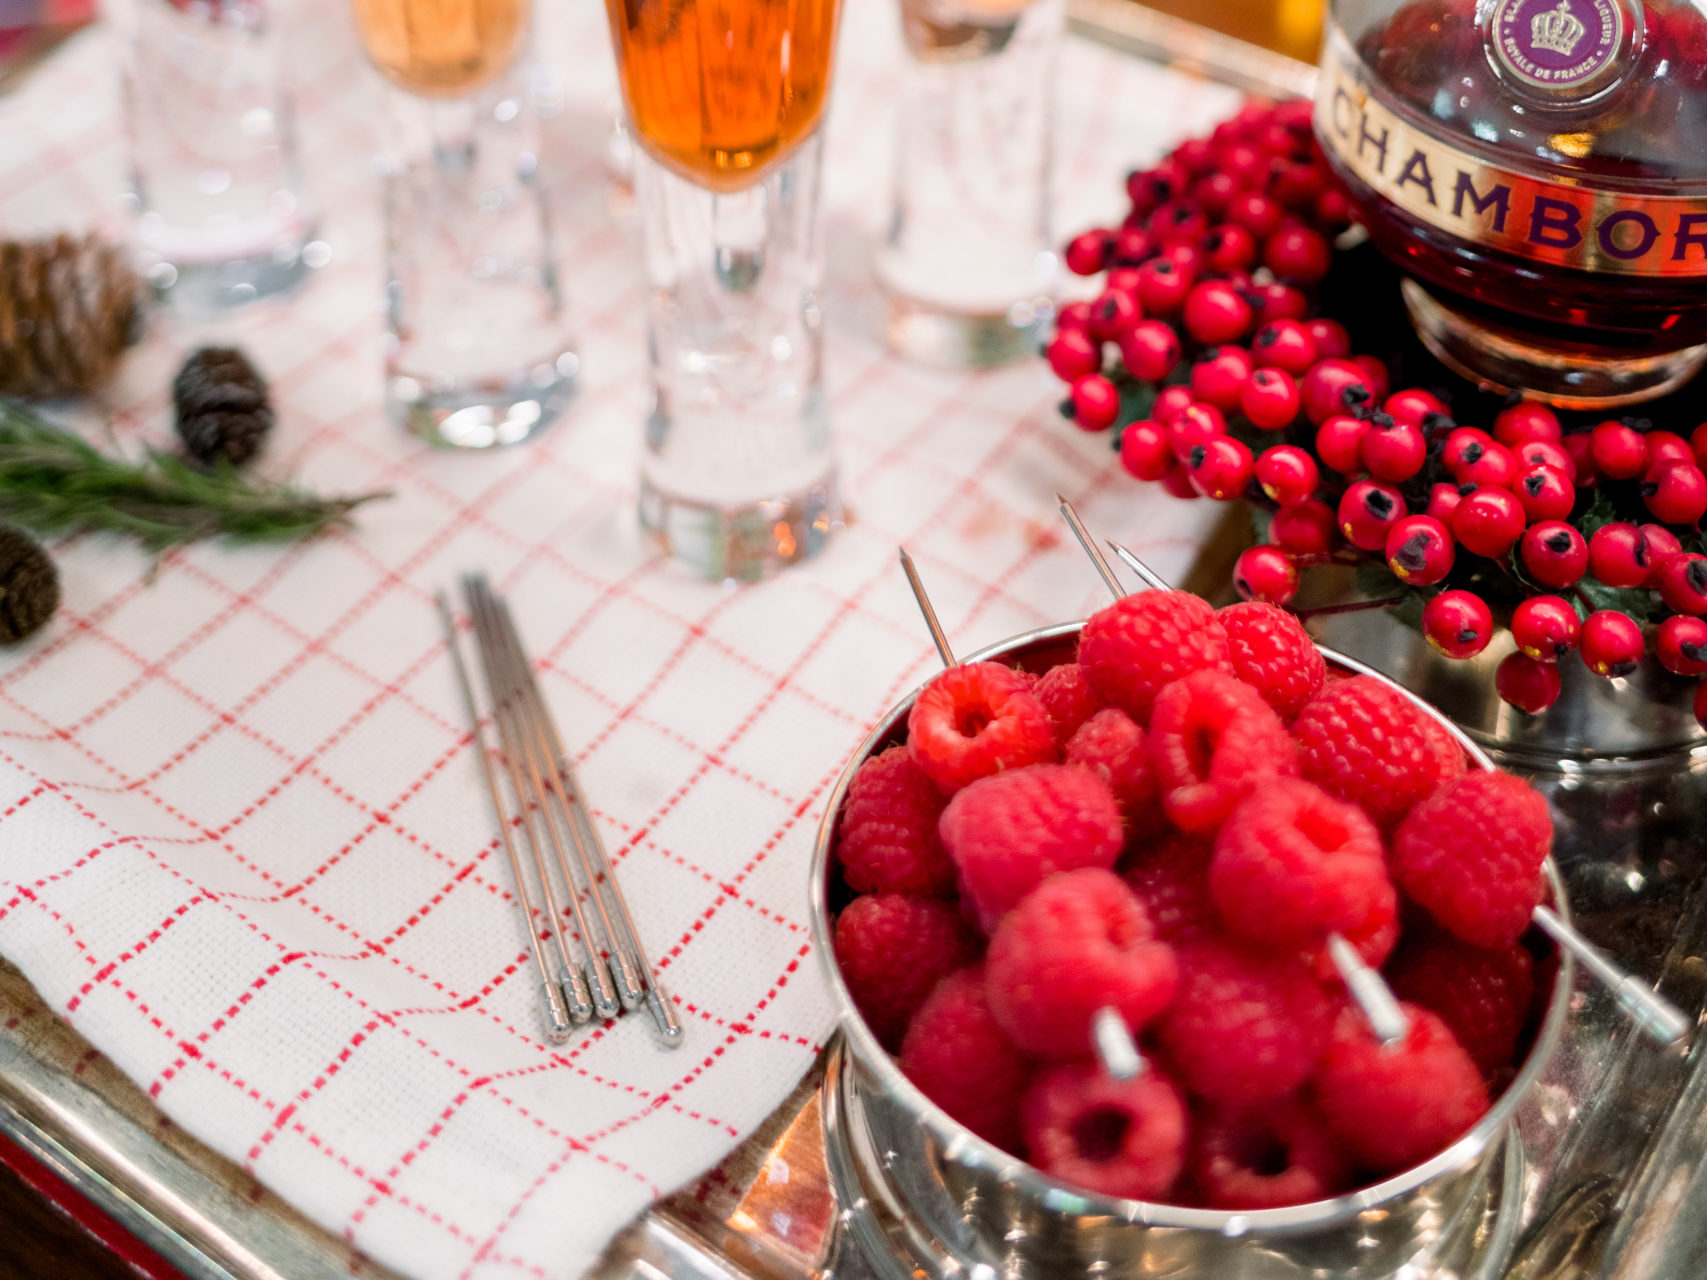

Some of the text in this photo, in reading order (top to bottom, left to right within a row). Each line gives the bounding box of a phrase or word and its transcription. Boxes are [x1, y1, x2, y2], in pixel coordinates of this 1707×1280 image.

[1504, 37, 1597, 80] ROYALE DE FRANCE
[1333, 88, 1707, 261] CHAMBOR
